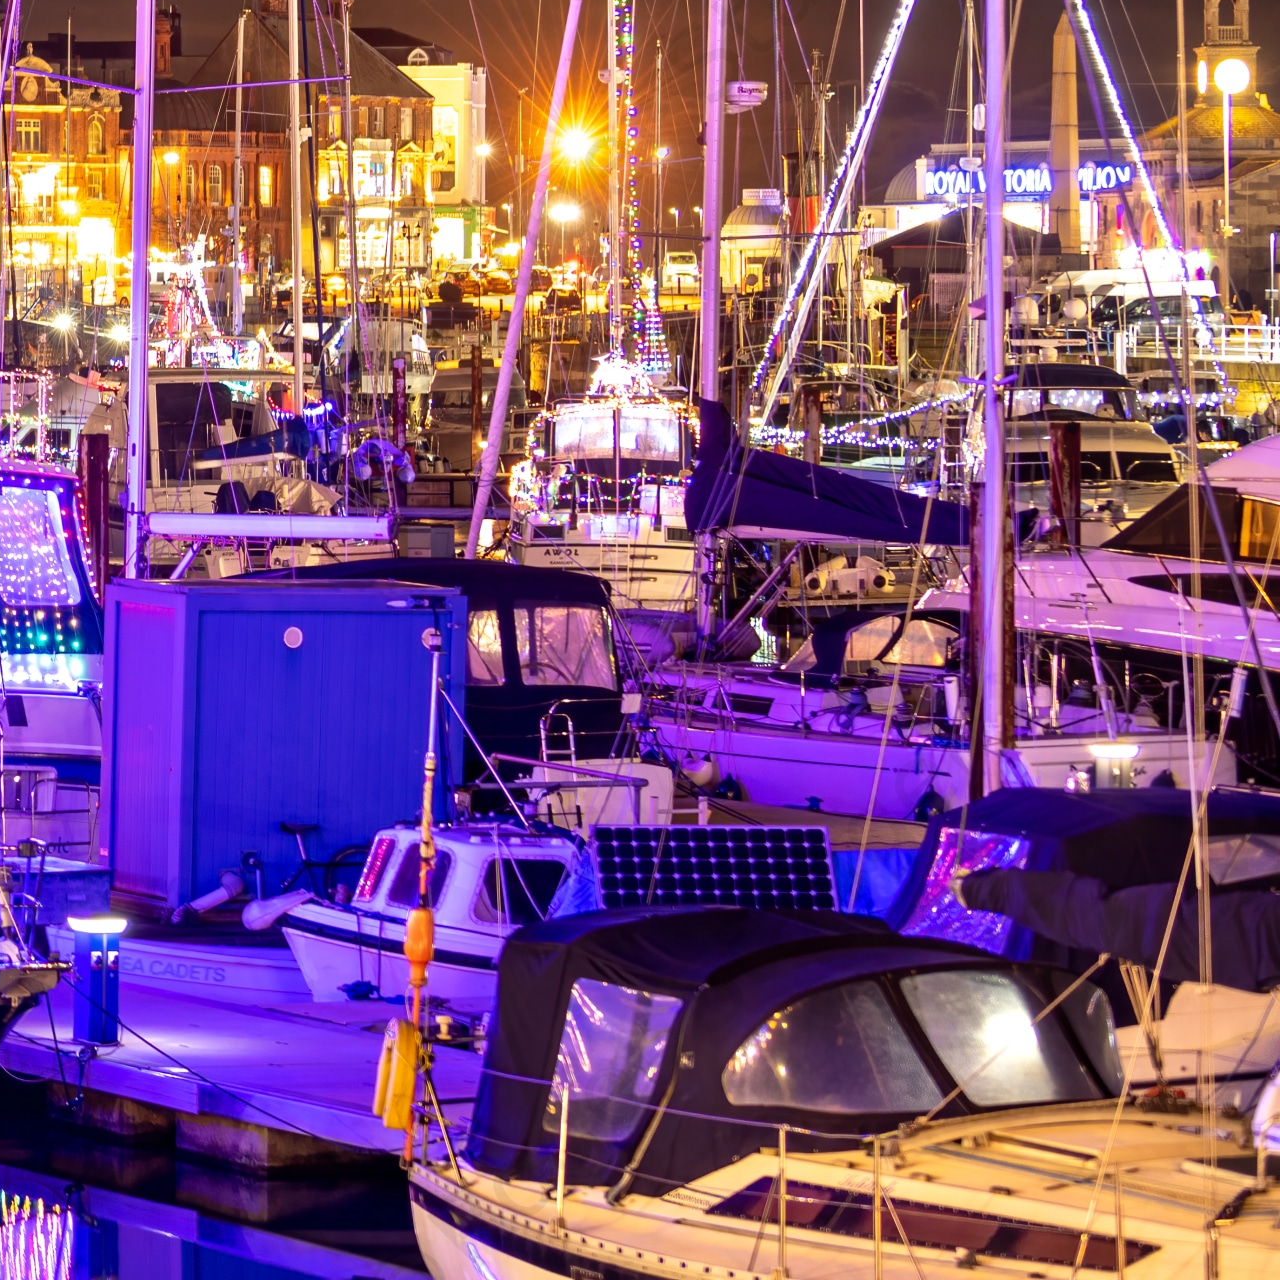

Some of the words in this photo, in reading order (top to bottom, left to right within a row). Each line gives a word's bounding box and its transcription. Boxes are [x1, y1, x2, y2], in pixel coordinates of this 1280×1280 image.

[925, 170, 976, 195] ROYAL
[977, 168, 1052, 193] VTORIA
[120, 956, 145, 973] EA
[149, 959, 226, 982] CADETS
